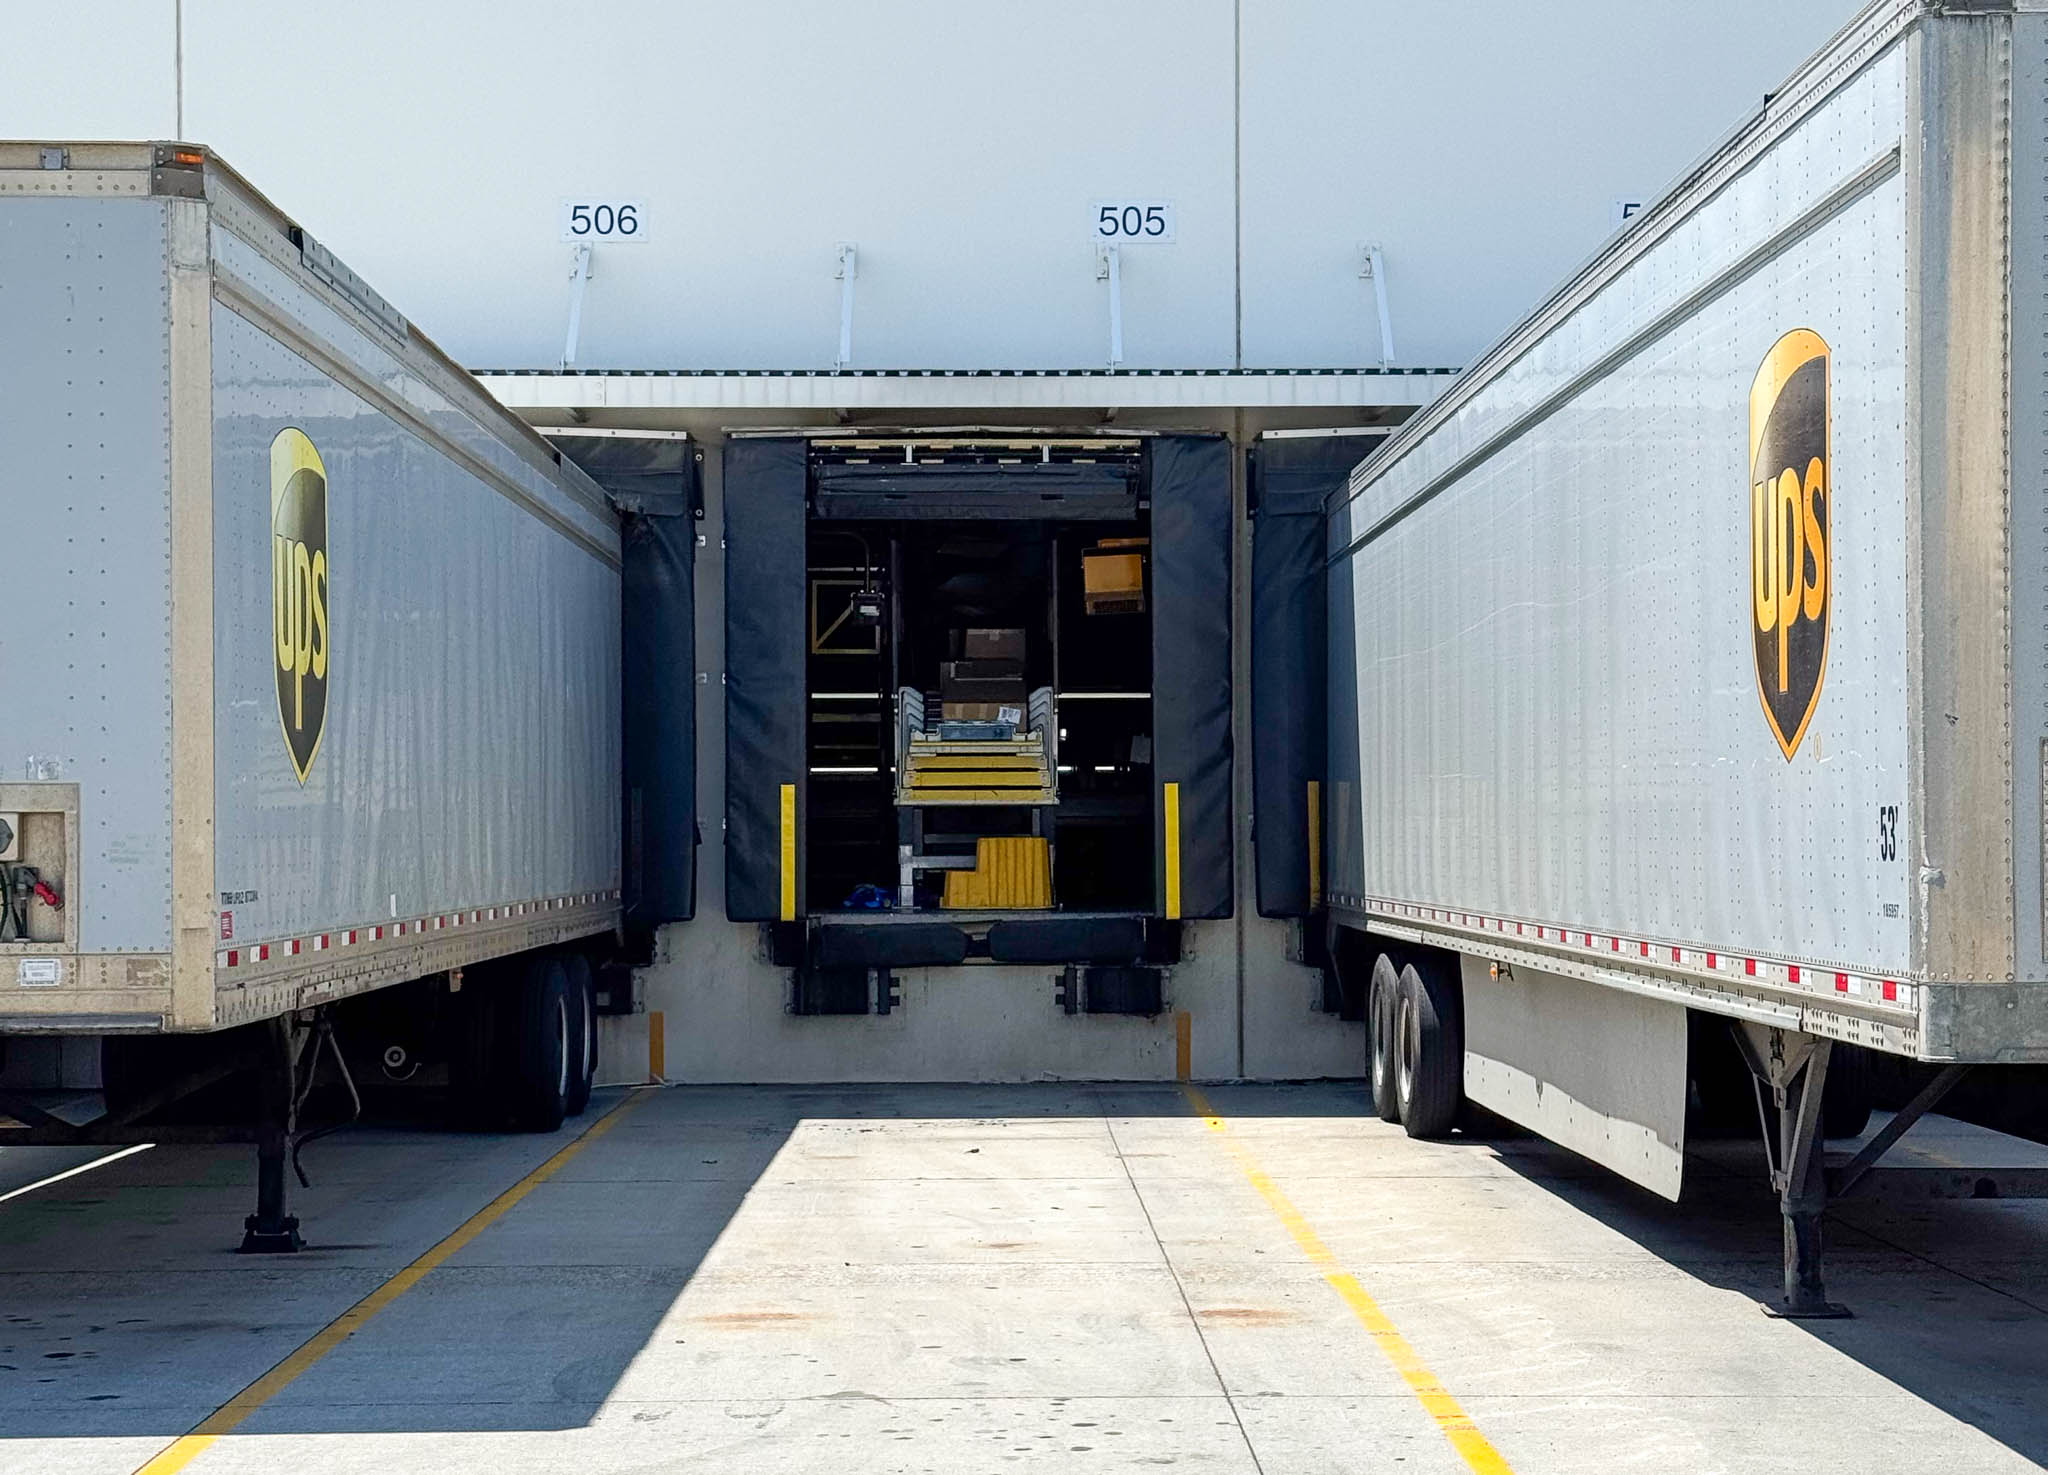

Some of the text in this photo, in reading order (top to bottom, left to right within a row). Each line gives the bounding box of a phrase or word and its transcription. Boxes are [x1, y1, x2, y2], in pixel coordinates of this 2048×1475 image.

[571, 205, 637, 235] 506
[1099, 206, 1165, 236] 505
[1755, 456, 1825, 693] ups
[276, 534, 326, 730] ups
